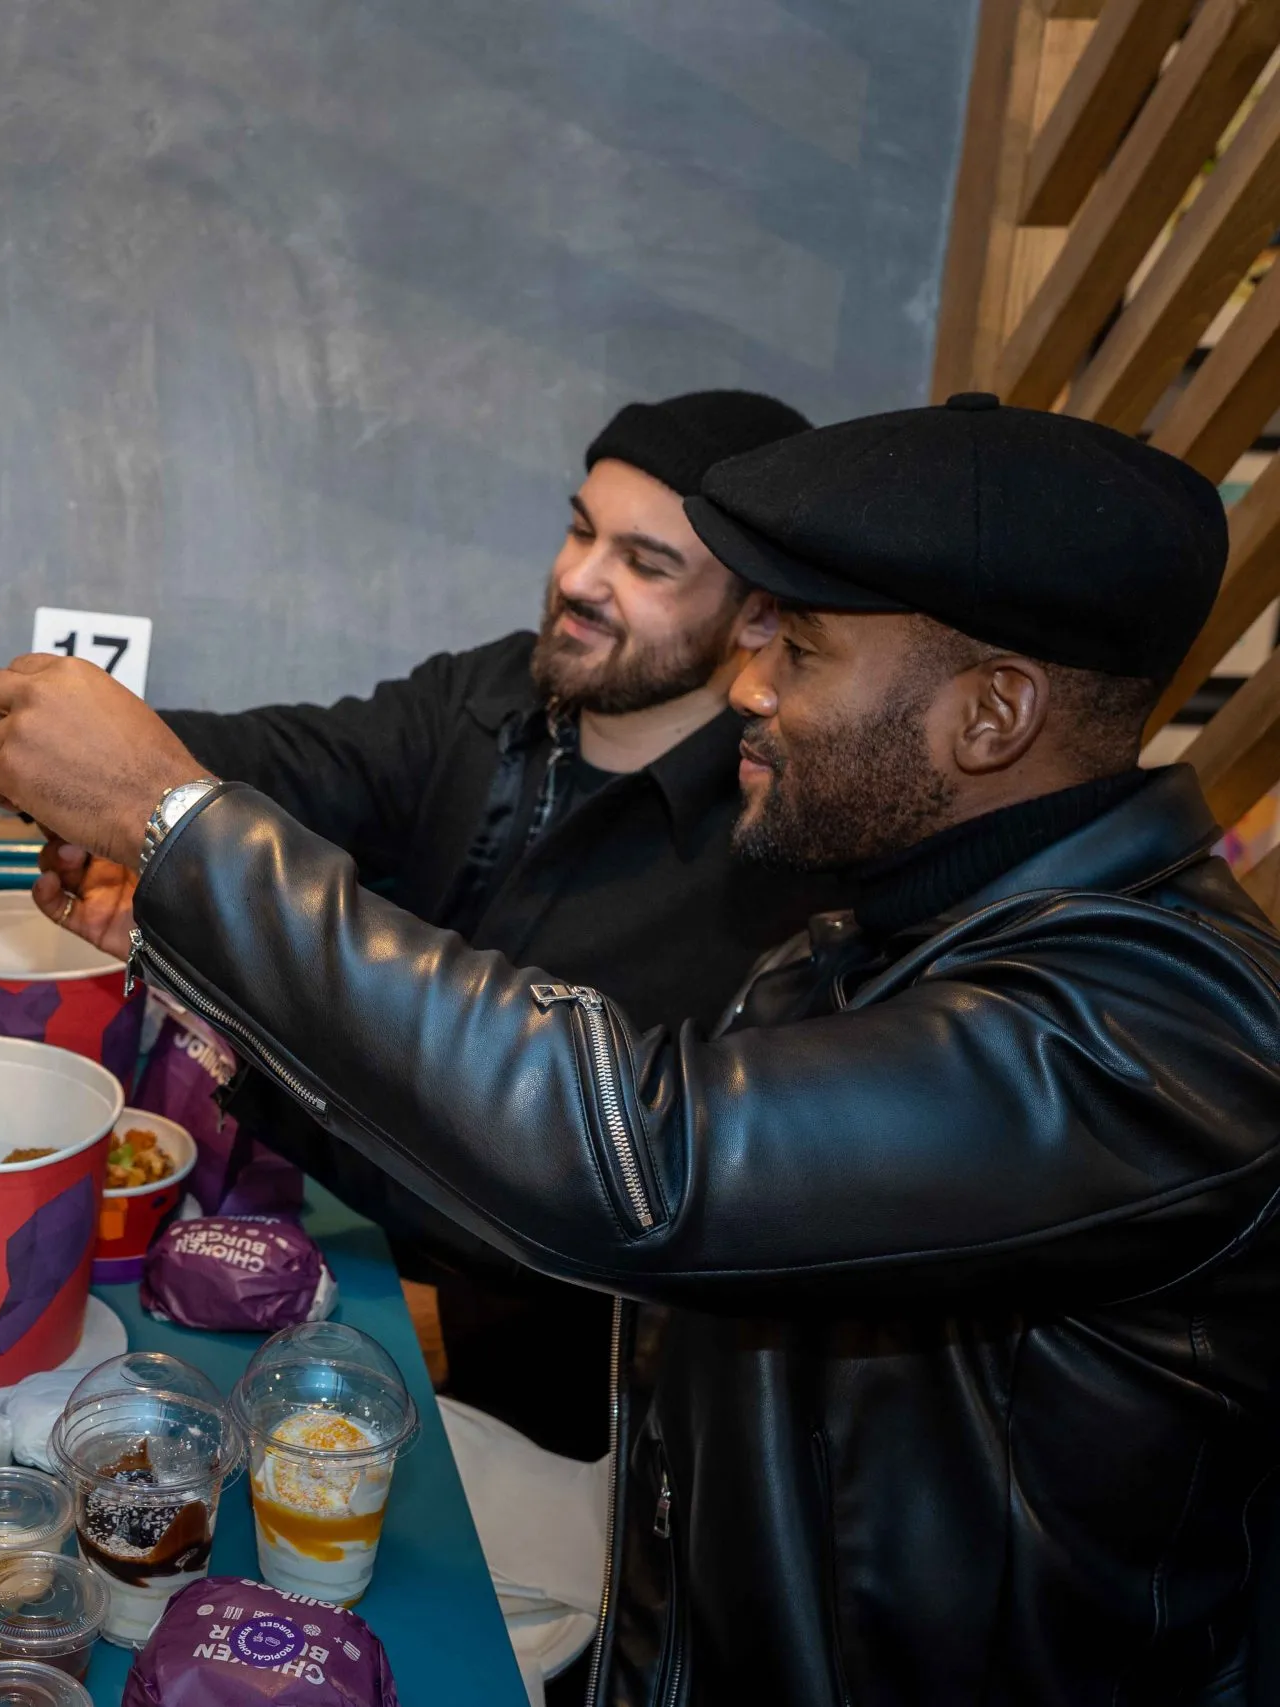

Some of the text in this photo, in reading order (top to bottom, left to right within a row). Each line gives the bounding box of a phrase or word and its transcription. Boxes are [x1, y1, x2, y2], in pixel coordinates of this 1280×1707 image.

[54, 631, 129, 674] 17
[175, 1239, 265, 1273] CHICKEN
[183, 1231, 267, 1256] BURGER
[237, 1626, 253, 1656] CHICKEN
[259, 1621, 296, 1639] BURGER
[252, 1643, 295, 1661] TROPICAL
